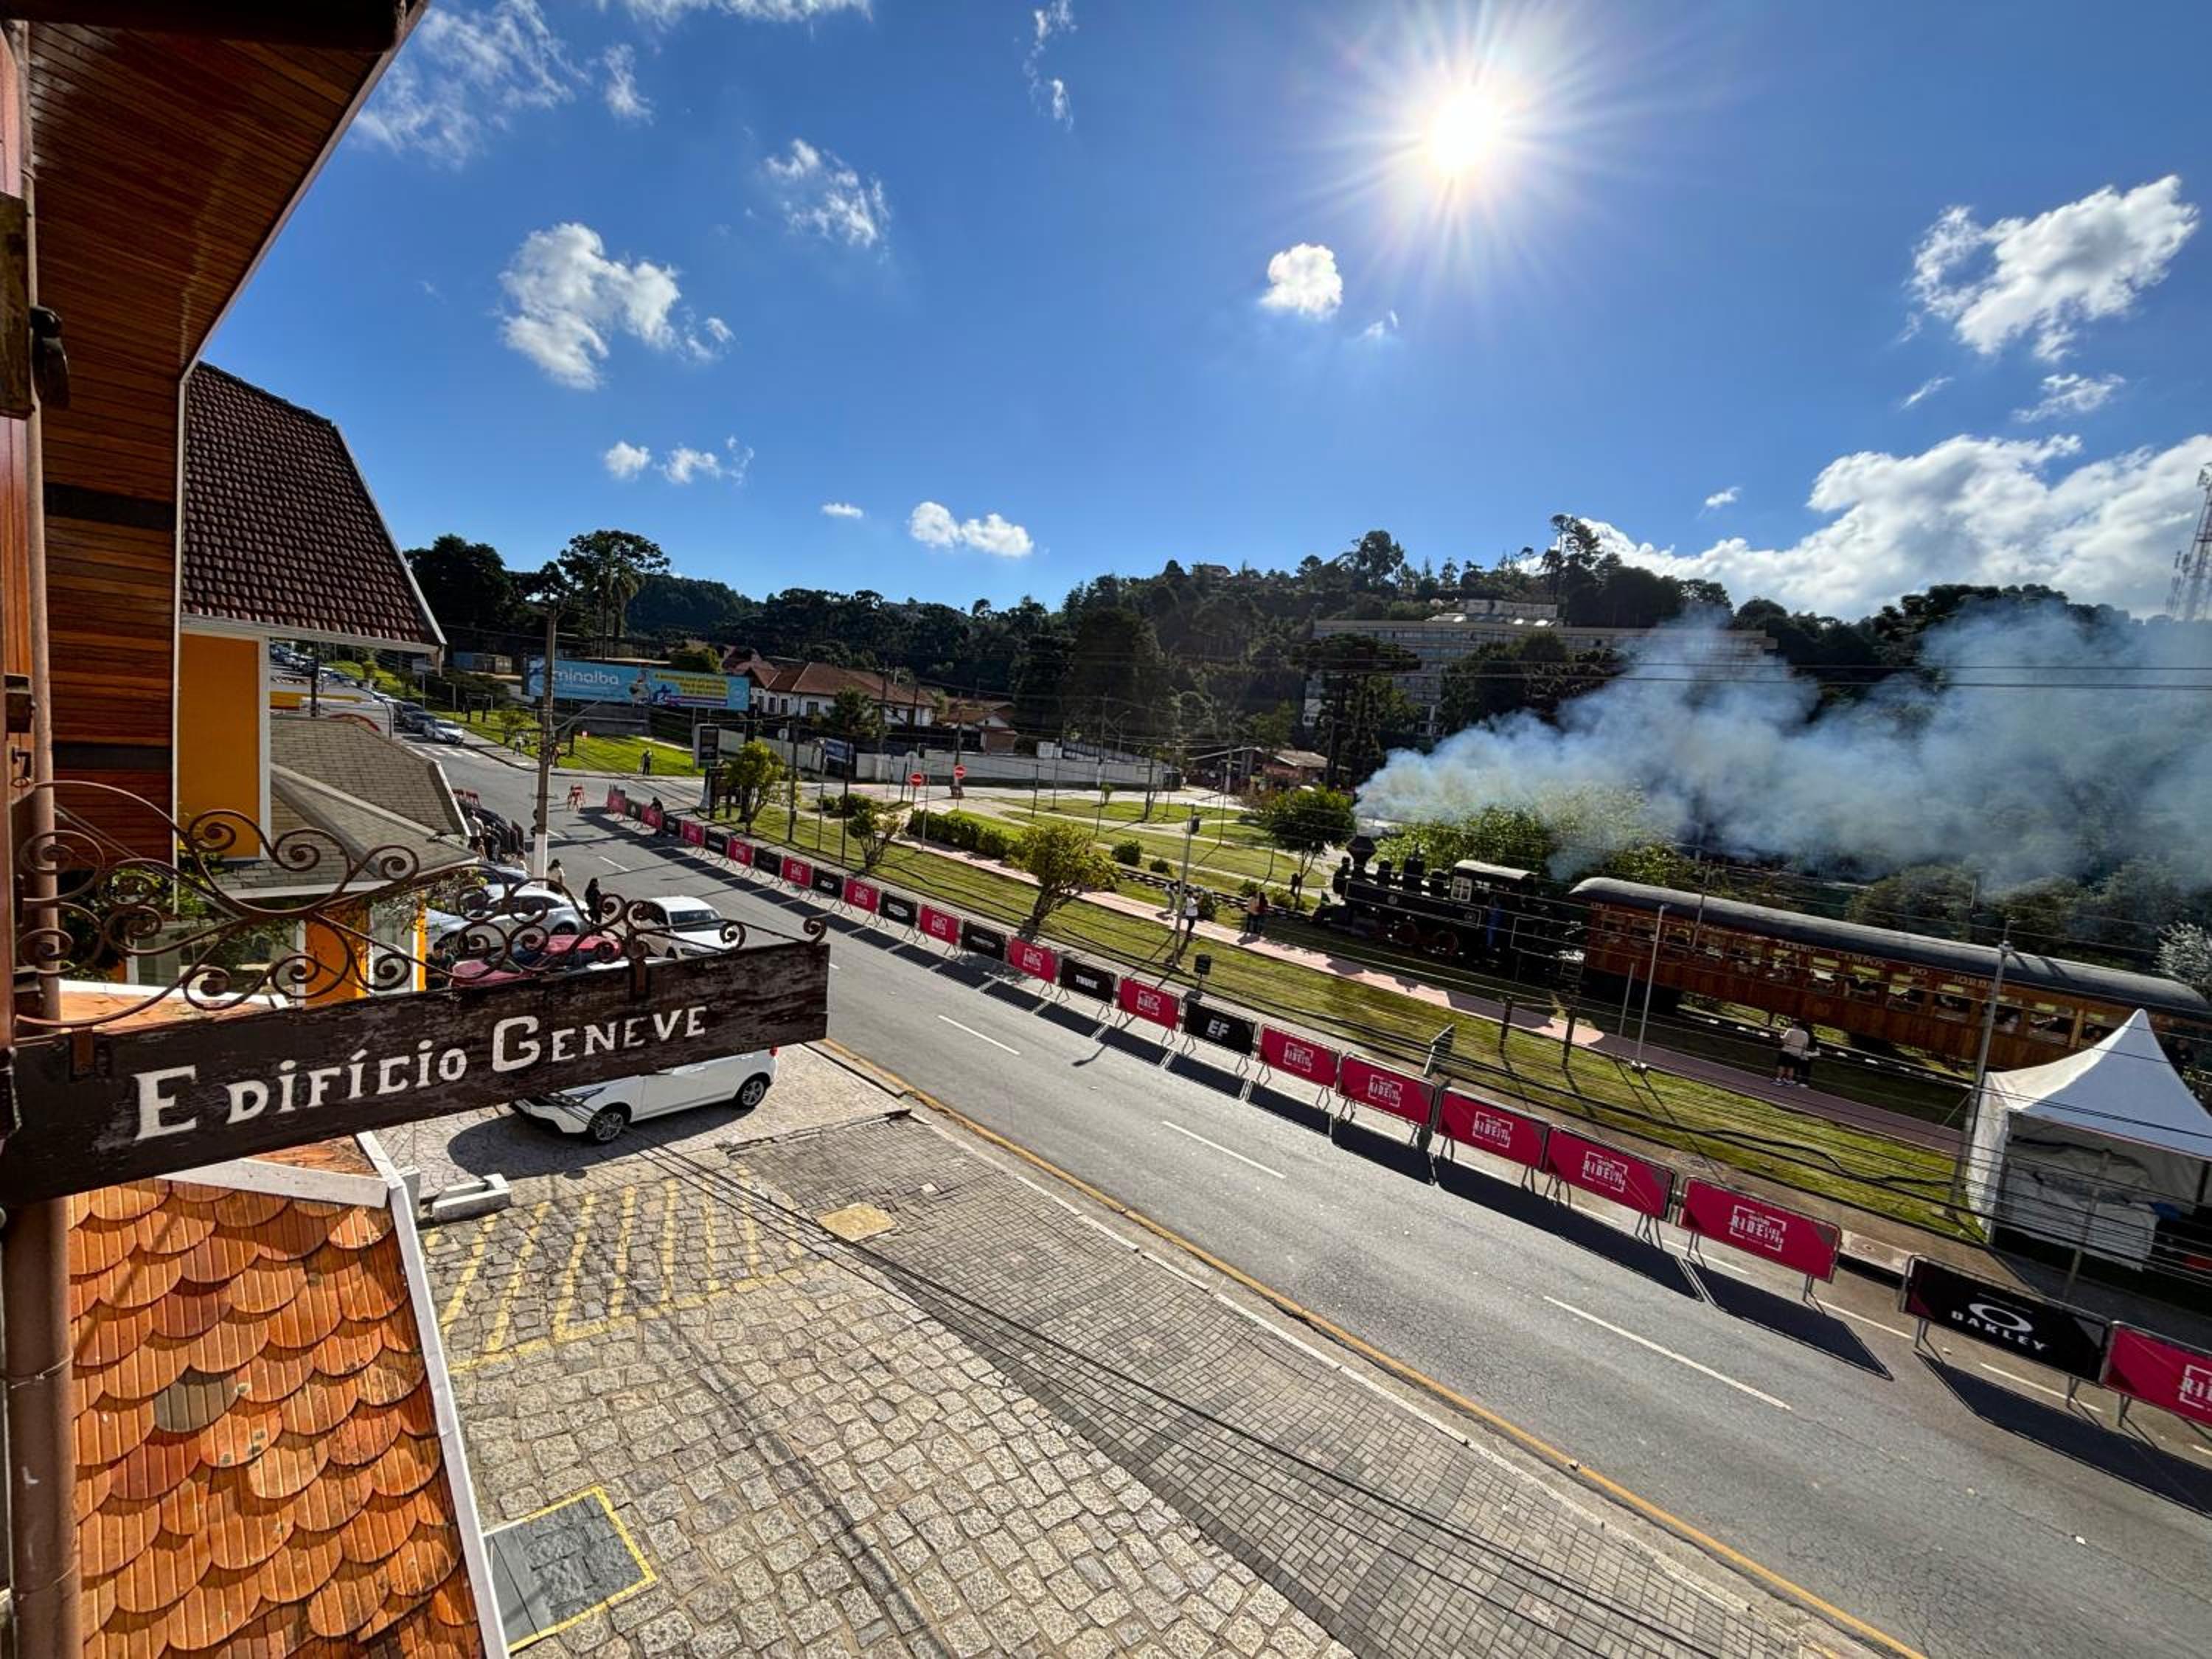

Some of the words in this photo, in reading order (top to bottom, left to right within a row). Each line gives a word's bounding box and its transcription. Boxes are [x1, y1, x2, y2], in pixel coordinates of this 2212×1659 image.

[1207, 1018, 1231, 1037] EF
[1728, 1214, 1764, 1237] RIDE
[1950, 1310, 2049, 1351] OAKLEY
